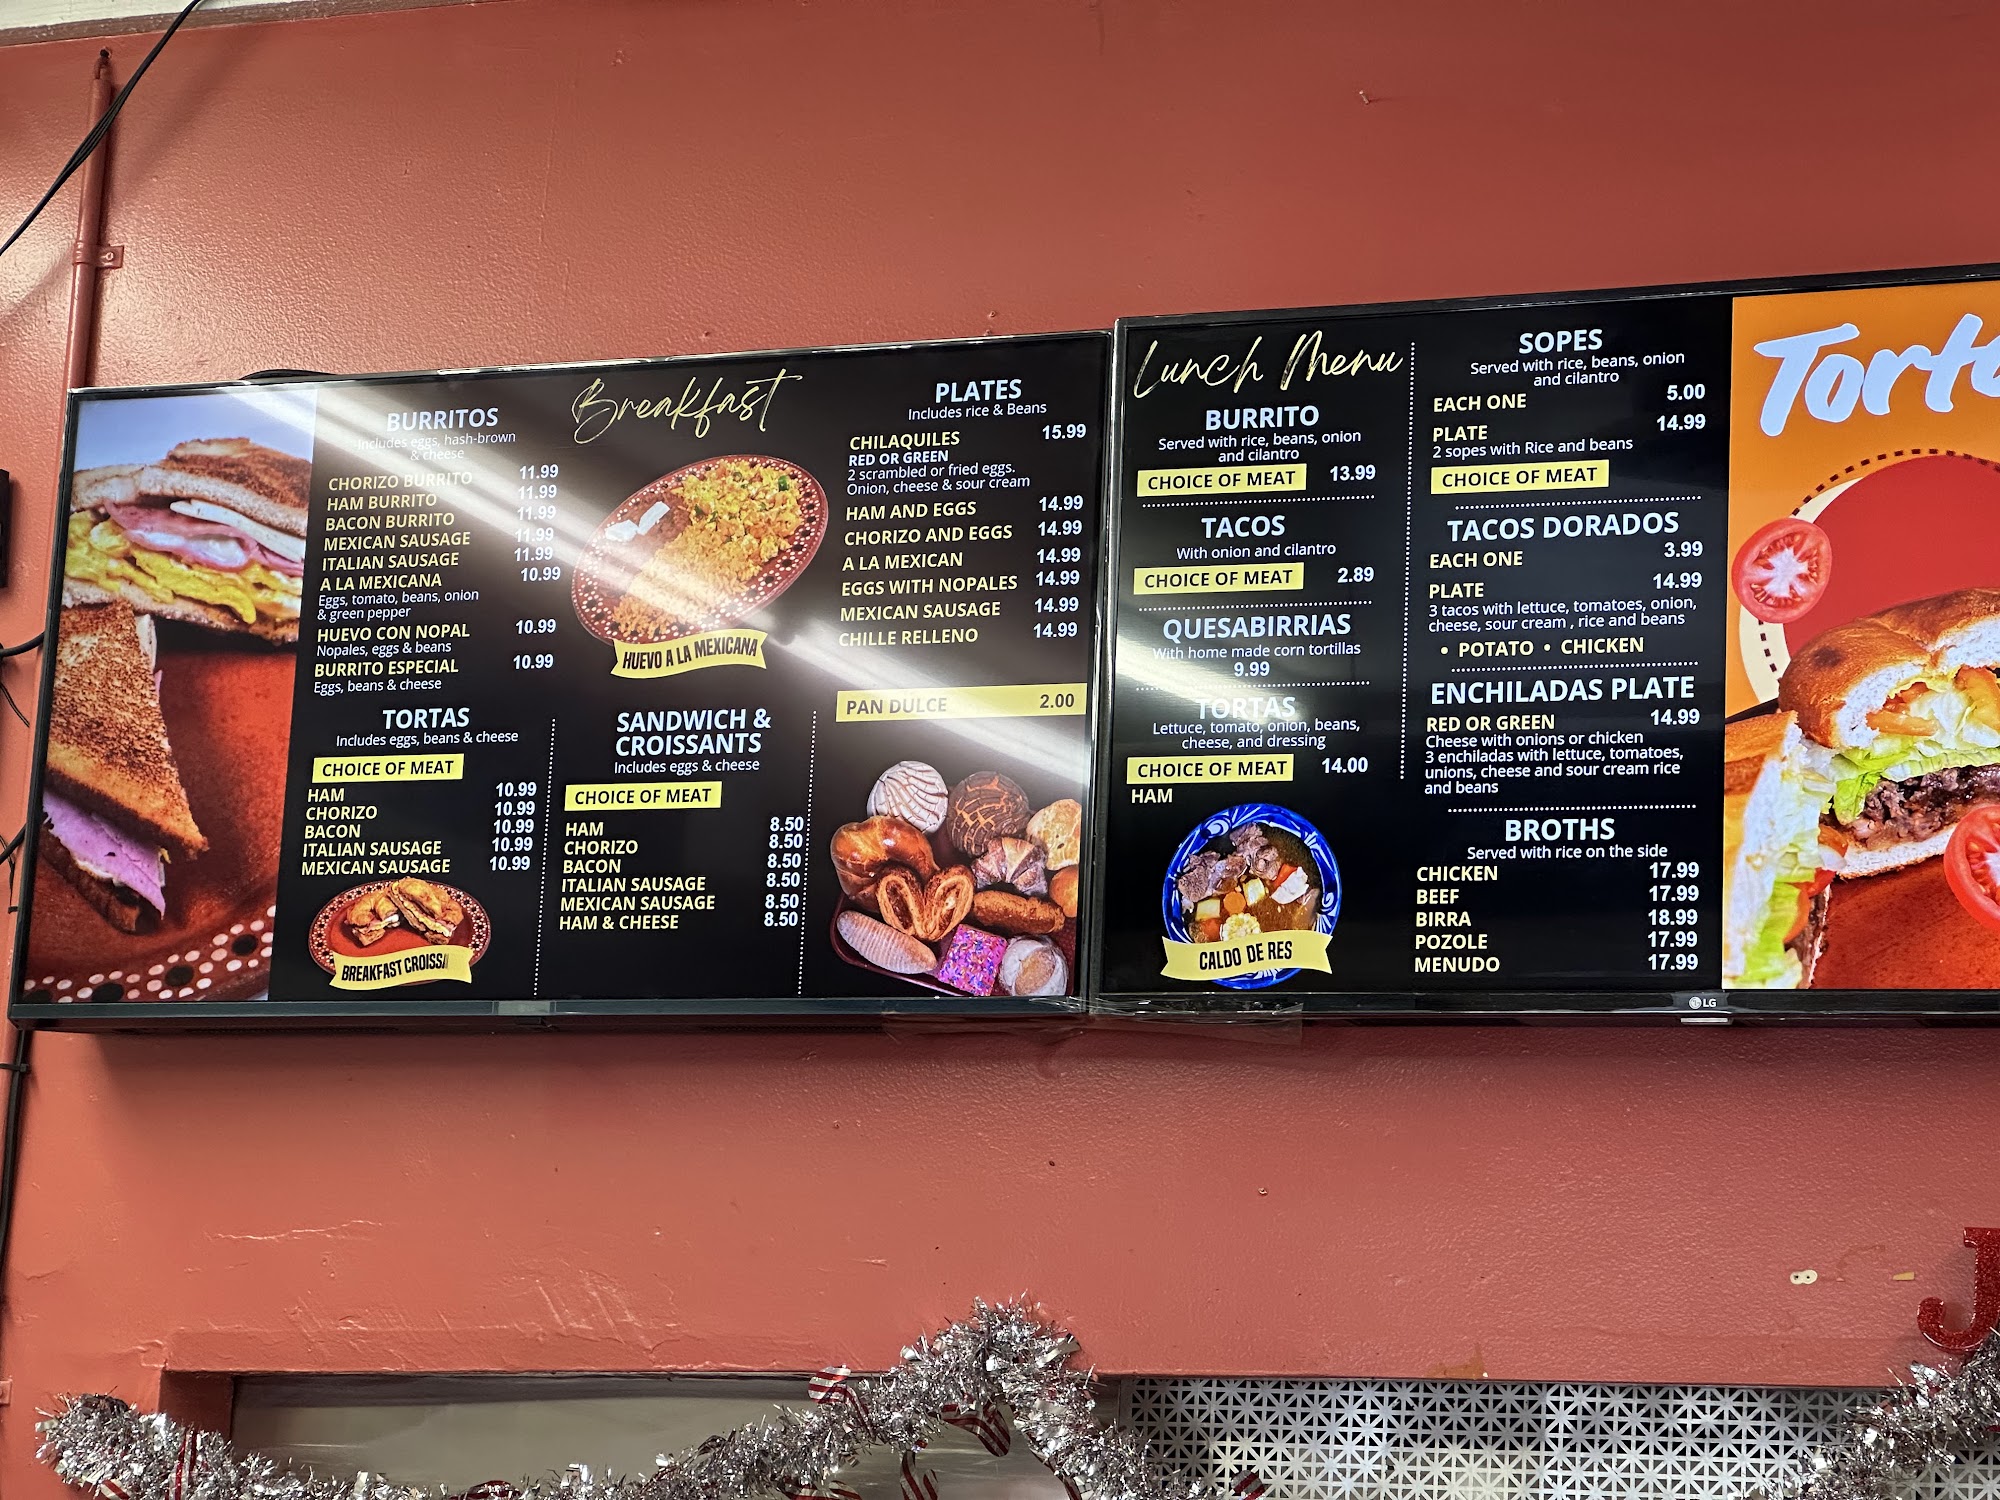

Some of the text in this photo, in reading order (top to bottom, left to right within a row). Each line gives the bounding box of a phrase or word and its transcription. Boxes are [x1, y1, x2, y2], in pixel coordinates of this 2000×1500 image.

[1519, 329, 1603, 354] SOPES
[1134, 330, 1404, 398] Lunch Menu
[936, 379, 1022, 403] PLATES
[1667, 384, 1705, 400] 5.00
[572, 369, 802, 444] Breakfast
[908, 403, 1047, 420] Includes rice & Beans
[1433, 394, 1526, 412] EACH ONE
[387, 408, 499, 432] BURRITOS
[1206, 405, 1319, 430] BURRITO
[1656, 414, 1705, 431] 14.99
[1042, 424, 1086, 439] 15.99
[1433, 425, 1488, 442] PLATE
[850, 432, 960, 450] CHILAQUILES
[1159, 431, 1361, 450] Served with rice, beans, onion
[1433, 438, 1633, 460] 2 sopes with Rice and beans
[519, 464, 559, 480] 11.99
[848, 462, 1015, 481] 2 scrambled or fried eggs.
[1330, 465, 1376, 481] 13.99
[329, 472, 472, 491] CHORIZO BURRITO
[846, 502, 977, 520] HAM AND EGGS
[1039, 495, 1083, 511] 14.99
[1202, 515, 1285, 538] TACOS
[1447, 512, 1679, 542] TACOS DORADOS
[324, 532, 470, 551] MEXICAN SAUSAGE
[1664, 541, 1703, 557] 3.99
[322, 553, 459, 571] ITALIAN SAUSAGE
[514, 547, 552, 562] 11.99
[320, 573, 442, 591] A LA MEXICANA
[1035, 570, 1080, 586] 14.99
[1338, 567, 1374, 583] 2.89
[842, 576, 1018, 596] EGGS WITH NOPALES
[318, 590, 478, 608] Eggs, tomato, beans, onion
[1429, 598, 1697, 617] 3 tacos with lettuce, tomatoes, onion,
[317, 624, 470, 642] HUEVO CON NOPAL
[515, 619, 556, 634] 10.99
[1033, 622, 1078, 638] 14.99
[1163, 614, 1350, 644] QUESABIRRIAS
[839, 628, 978, 646] CHILLE RELLENO
[622, 637, 758, 669] HUEVO A LA MEXICANA
[1153, 642, 1360, 659] With home made corn tortillas
[1459, 637, 1644, 657] POTATO CHICKEN
[314, 659, 459, 677] BURRITO ESPECIAL
[1234, 662, 1270, 677] 9.99
[1431, 676, 1695, 705] ENCHILADAS PLATE
[847, 698, 947, 714] PAN DULCE
[1040, 694, 1074, 708] 2.00
[1196, 697, 1295, 719] TORTAS
[383, 707, 470, 729] TORTAS
[617, 708, 771, 733] SANDWICH &
[1426, 714, 1555, 732] RED OR GREEN
[1153, 719, 1360, 736] Lettuce, tomato, onion, beans,
[336, 731, 518, 748] Includes eggs, beans & cheese
[616, 733, 762, 756] CROISSANTS
[1425, 747, 1683, 763] 3 enchiladas with lettuce, tomatoes,
[322, 760, 454, 777] CHOICE OF MEAT
[1322, 757, 1368, 773] 14.00
[495, 782, 537, 797] 10.99
[304, 824, 361, 839] BACON
[770, 817, 804, 831] 8.50
[1505, 818, 1615, 841] BROTHS
[492, 837, 533, 852] 10.99
[1467, 844, 1667, 859] Served with rice on the side
[1416, 865, 1498, 882] CHICKEN
[1650, 862, 1699, 878] 17.99
[765, 894, 799, 908] 8.50
[1416, 889, 1459, 904] BEEF
[1416, 911, 1471, 927] BIRRA
[1648, 909, 1698, 925] 18.99
[1415, 934, 1488, 950] POZOLE
[1648, 931, 1698, 948] 17.99
[1200, 941, 1292, 970] CALDO DE RES
[341, 961, 402, 982] BREAKFAST
[1415, 957, 1500, 973] MENUDO
